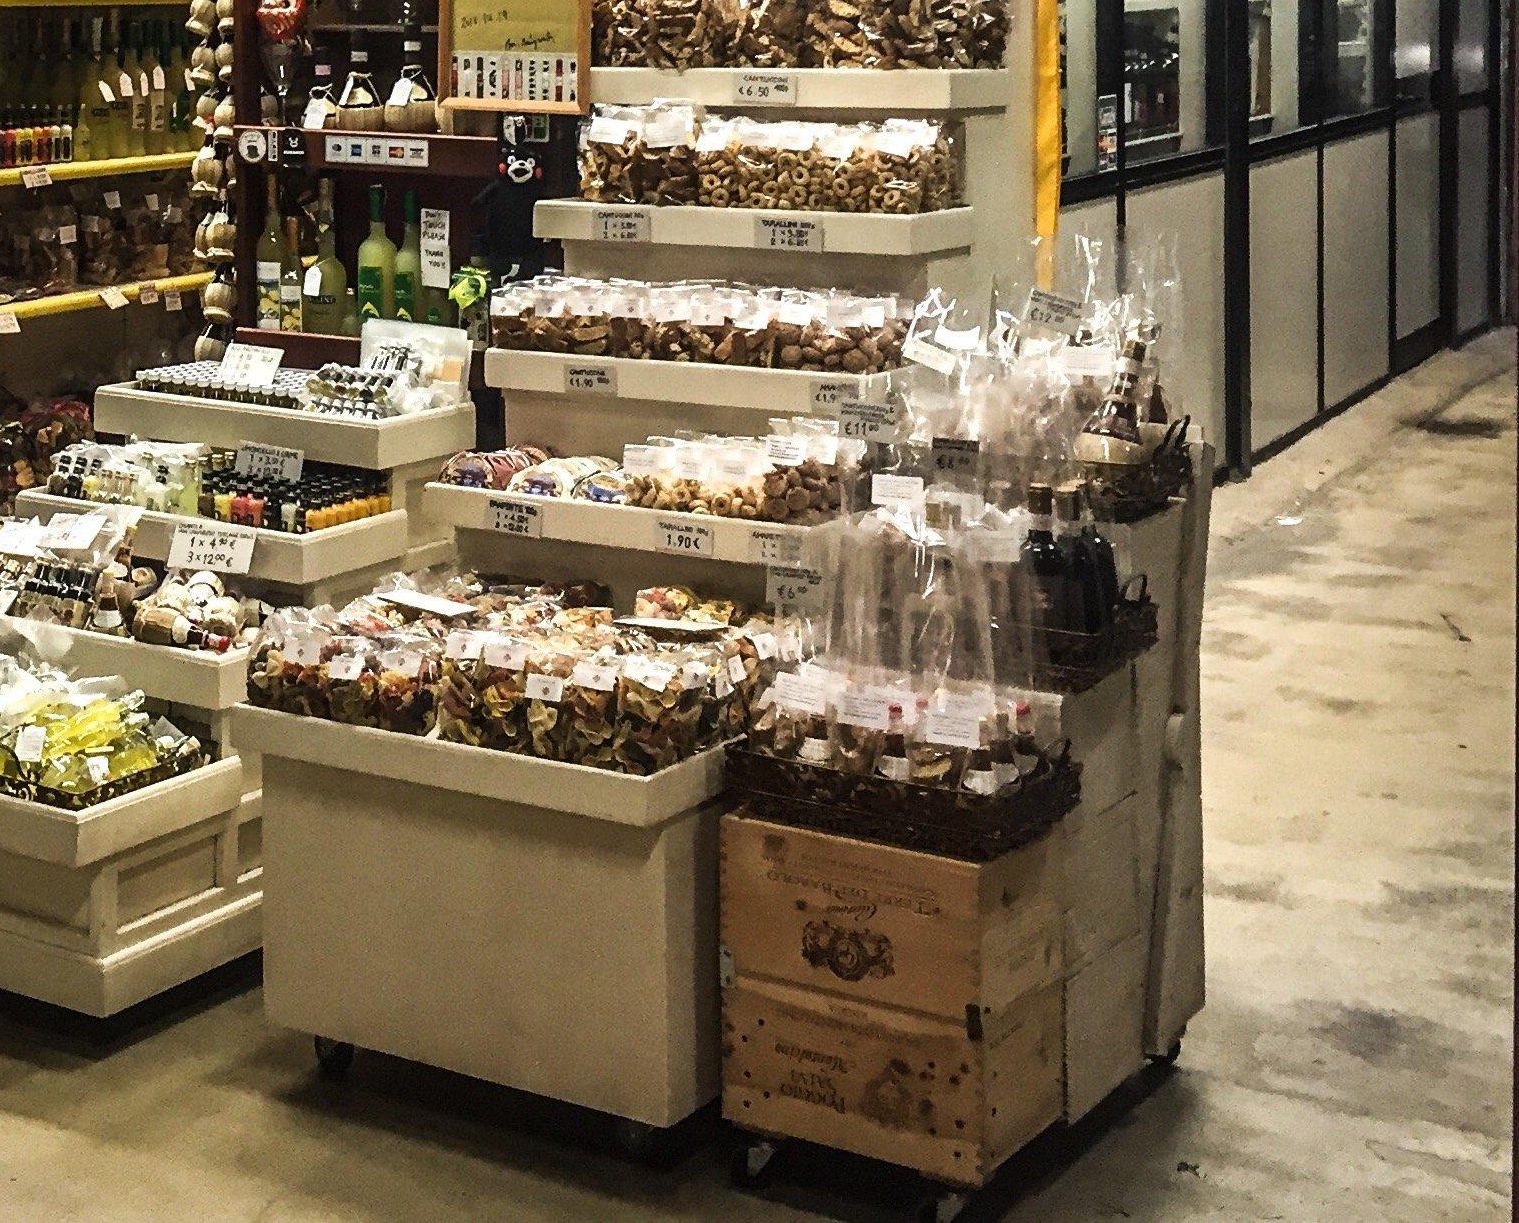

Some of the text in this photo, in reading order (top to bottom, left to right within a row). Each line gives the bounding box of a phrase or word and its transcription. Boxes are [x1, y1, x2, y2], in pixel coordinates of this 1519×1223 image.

[604, 221, 608, 230] 1
[772, 228, 775, 237] 1
[190, 537, 196, 547] 1
[229, 539, 236, 549] €
[187, 550, 194, 563] 3
[226, 557, 233, 567] €
